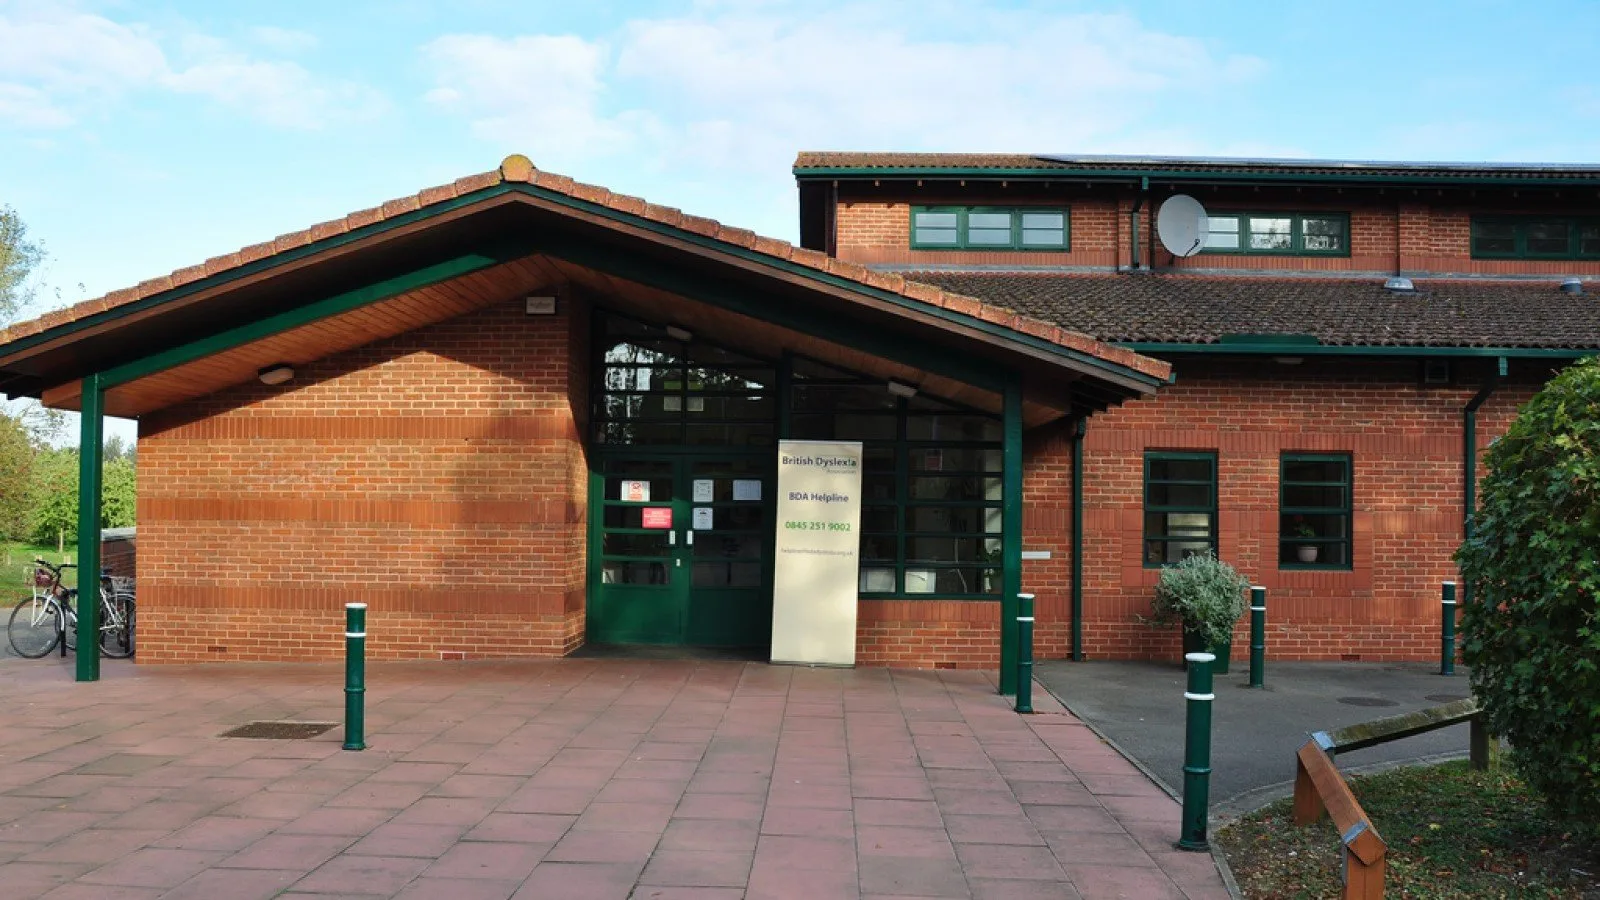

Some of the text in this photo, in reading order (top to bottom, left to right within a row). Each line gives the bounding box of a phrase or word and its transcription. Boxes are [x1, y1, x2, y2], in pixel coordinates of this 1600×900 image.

[782, 456, 814, 465] British
[788, 491, 849, 503] BDA Helpline
[785, 520, 851, 531] 0845 251 9002
